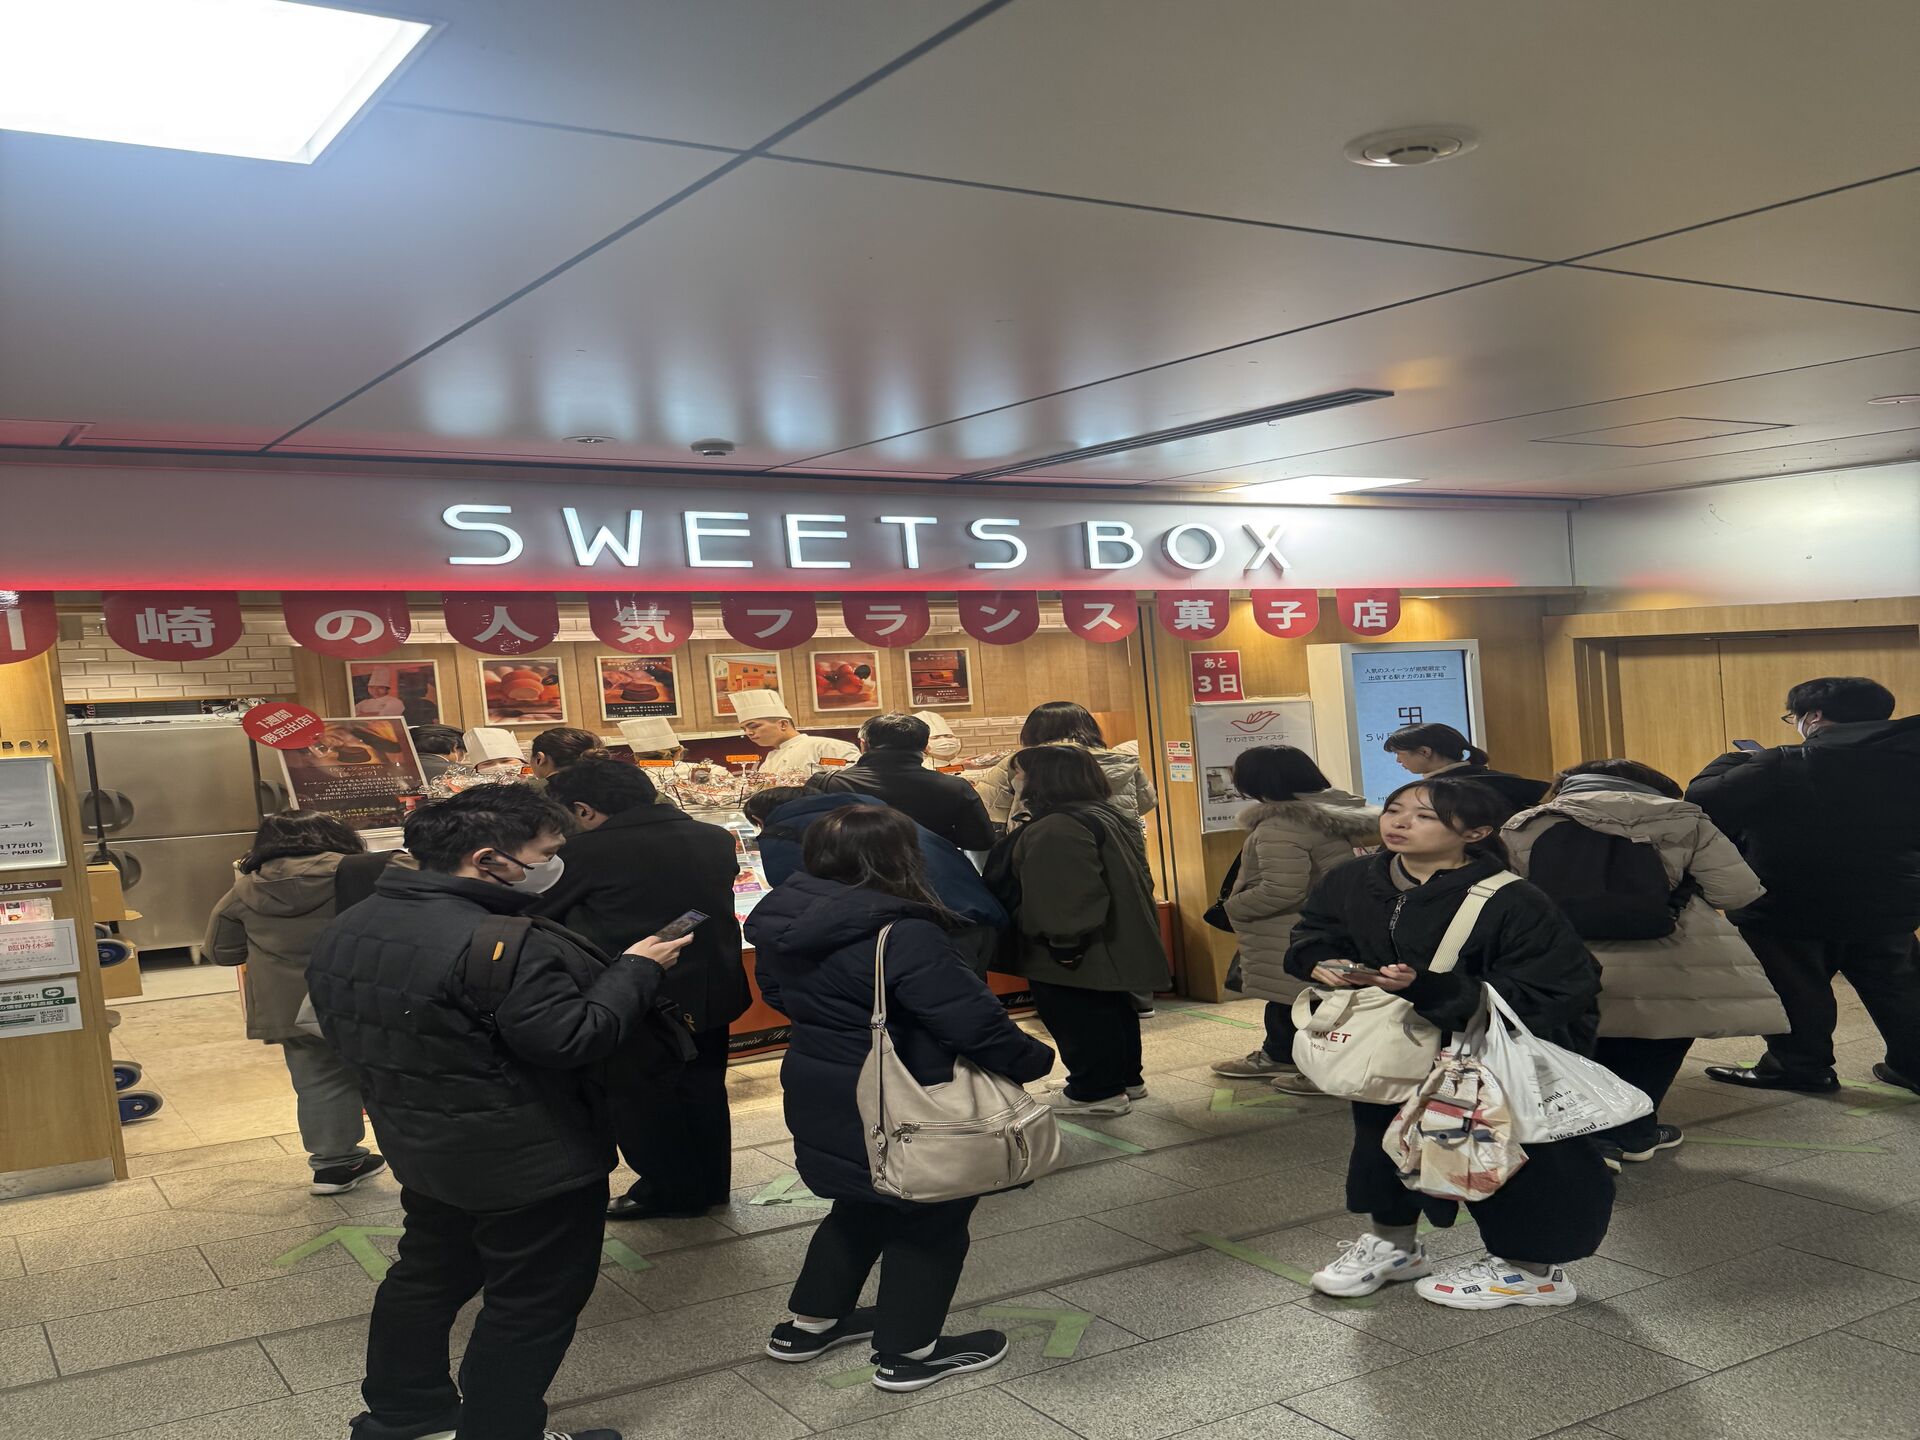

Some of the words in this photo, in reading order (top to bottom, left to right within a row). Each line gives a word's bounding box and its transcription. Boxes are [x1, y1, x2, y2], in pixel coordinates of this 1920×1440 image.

[442, 503, 1029, 569] SWEETS
[1082, 519, 1292, 571] BOX
[1204, 657, 1228, 669] あと
[1197, 674, 1238, 693] 3日
[256, 709, 293, 729] 1週間
[1577, 1121, 1597, 1134] and
